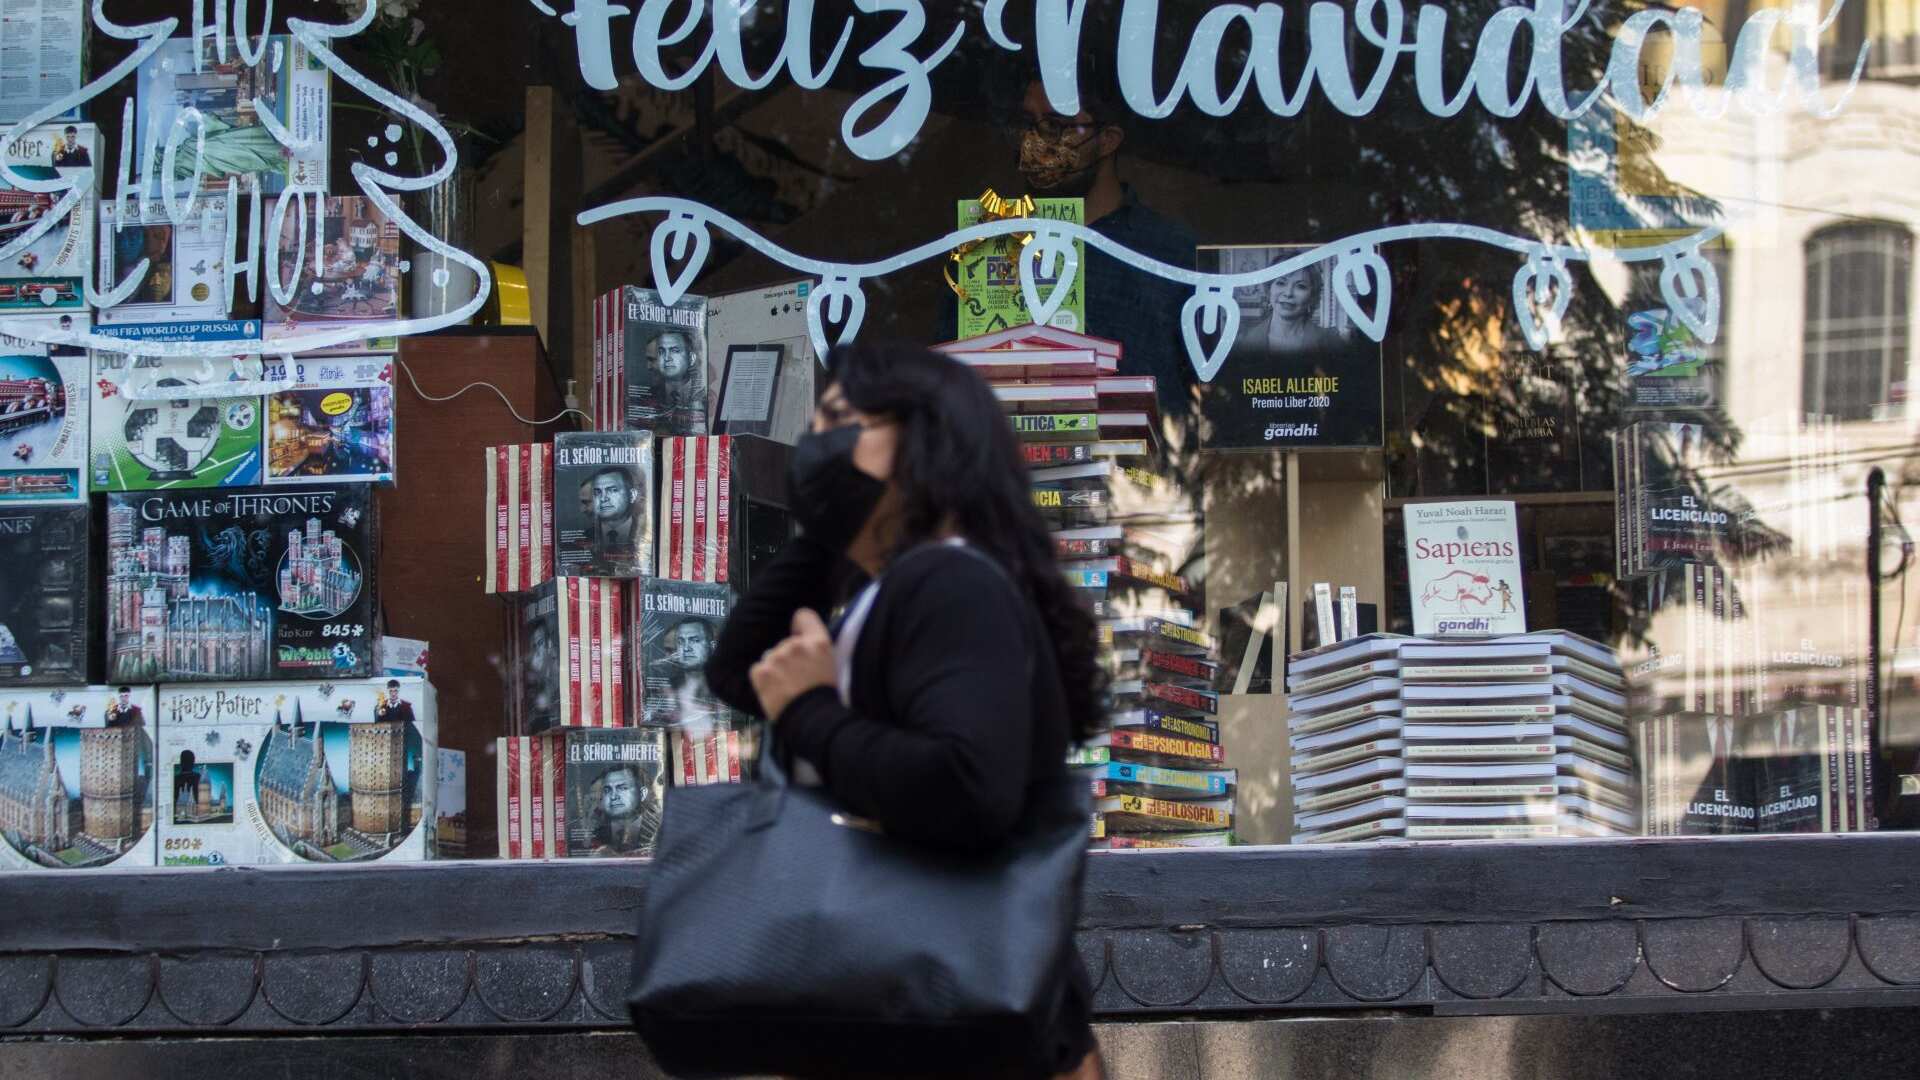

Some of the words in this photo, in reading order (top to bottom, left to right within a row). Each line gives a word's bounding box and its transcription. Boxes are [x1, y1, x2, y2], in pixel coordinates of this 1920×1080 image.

[2, 138, 43, 160] otter
[628, 303, 639, 320] EL
[640, 303, 666, 323] SEÑOR
[673, 308, 704, 329] MUERTE
[120, 326, 141, 335] FIFA
[142, 325, 177, 335] WORLD
[179, 324, 200, 334] CUP
[202, 323, 238, 333] RUSSIA
[271, 364, 304, 376] 100
[1243, 378, 1283, 394] ISABEL
[1286, 377, 1339, 393] ALLENDE
[1252, 396, 1282, 408] Premio
[1285, 396, 1306, 408] Liber
[1308, 396, 1330, 407] 2020
[1011, 415, 1055, 431] LITICA
[1264, 424, 1317, 440] gandhi
[560, 448, 570, 465] EL
[573, 446, 602, 464] SEÑOR
[610, 447, 647, 464] MUERTE
[142, 498, 211, 521] GAME
[214, 502, 230, 514] OF
[230, 492, 335, 518] THRONES
[1682, 496, 1698, 508] EL
[1651, 508, 1727, 524] LICENCIADO
[1415, 537, 1513, 564] Sapiens
[644, 593, 655, 611] EL
[657, 593, 685, 612] SEÑOR
[692, 597, 726, 617] MUERTE
[322, 624, 350, 637] 845
[1438, 617, 1489, 633] gandhi
[1772, 651, 1842, 668] LICENCIADO
[169, 695, 213, 723] Harry
[217, 691, 261, 722] Potter
[571, 744, 581, 761] EL
[583, 743, 613, 761] SEÑOR
[621, 743, 658, 761] MUERTE
[1715, 789, 1730, 802] EL
[1780, 785, 1792, 798] EL
[1167, 801, 1215, 823] FILOSOFIA
[1686, 802, 1754, 819] LICENCIADO
[1760, 794, 1817, 818] LICENCIADO
[164, 838, 190, 850] 850
